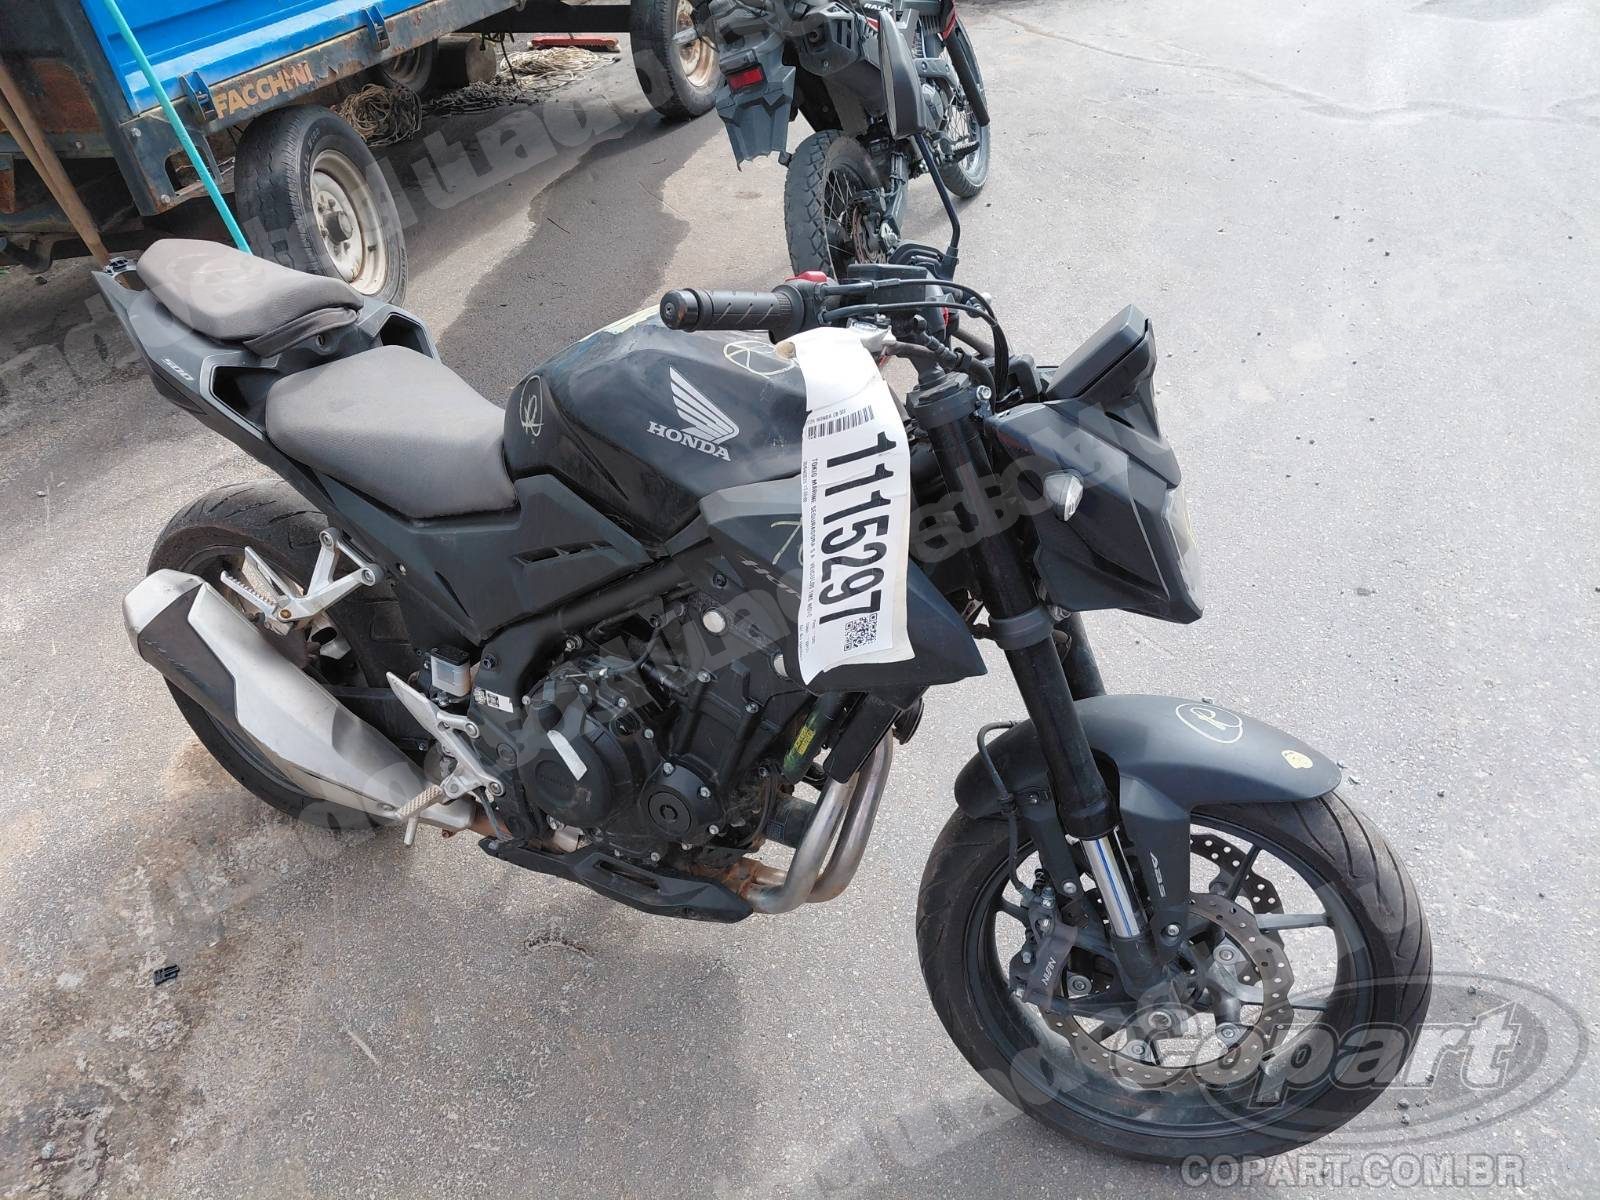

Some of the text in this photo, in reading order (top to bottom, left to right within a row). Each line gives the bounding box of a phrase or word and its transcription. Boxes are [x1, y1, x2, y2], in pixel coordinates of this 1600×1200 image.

[213, 60, 314, 119] FACCHINI
[160, 358, 194, 381] 500
[646, 421, 732, 461] HONDA
[819, 431, 897, 625] 1115297
